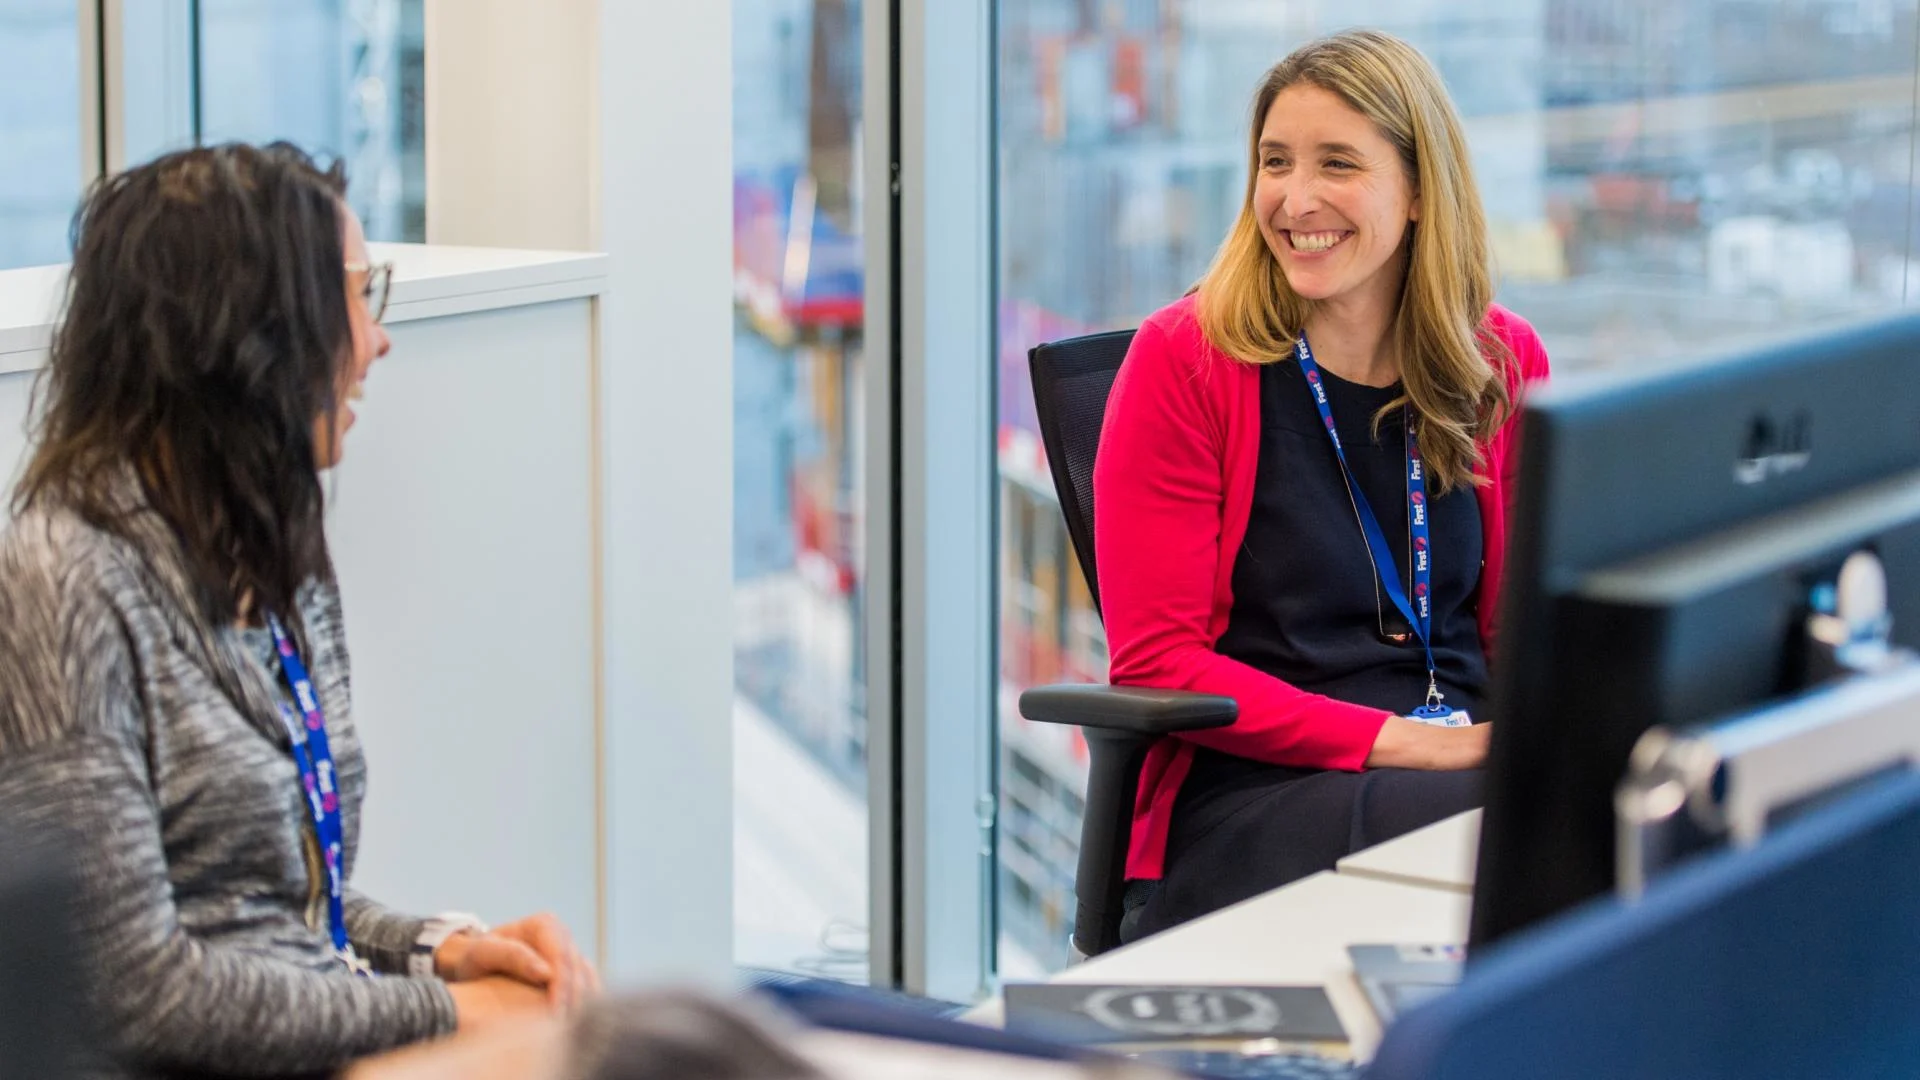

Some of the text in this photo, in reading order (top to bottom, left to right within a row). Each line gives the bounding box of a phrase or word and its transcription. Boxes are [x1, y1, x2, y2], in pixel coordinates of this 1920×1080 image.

[1313, 383, 1326, 404] First
[1411, 459, 1421, 480] First
[1414, 504, 1424, 525] First
[1417, 550, 1427, 571] First
[1420, 596, 1428, 618] First
